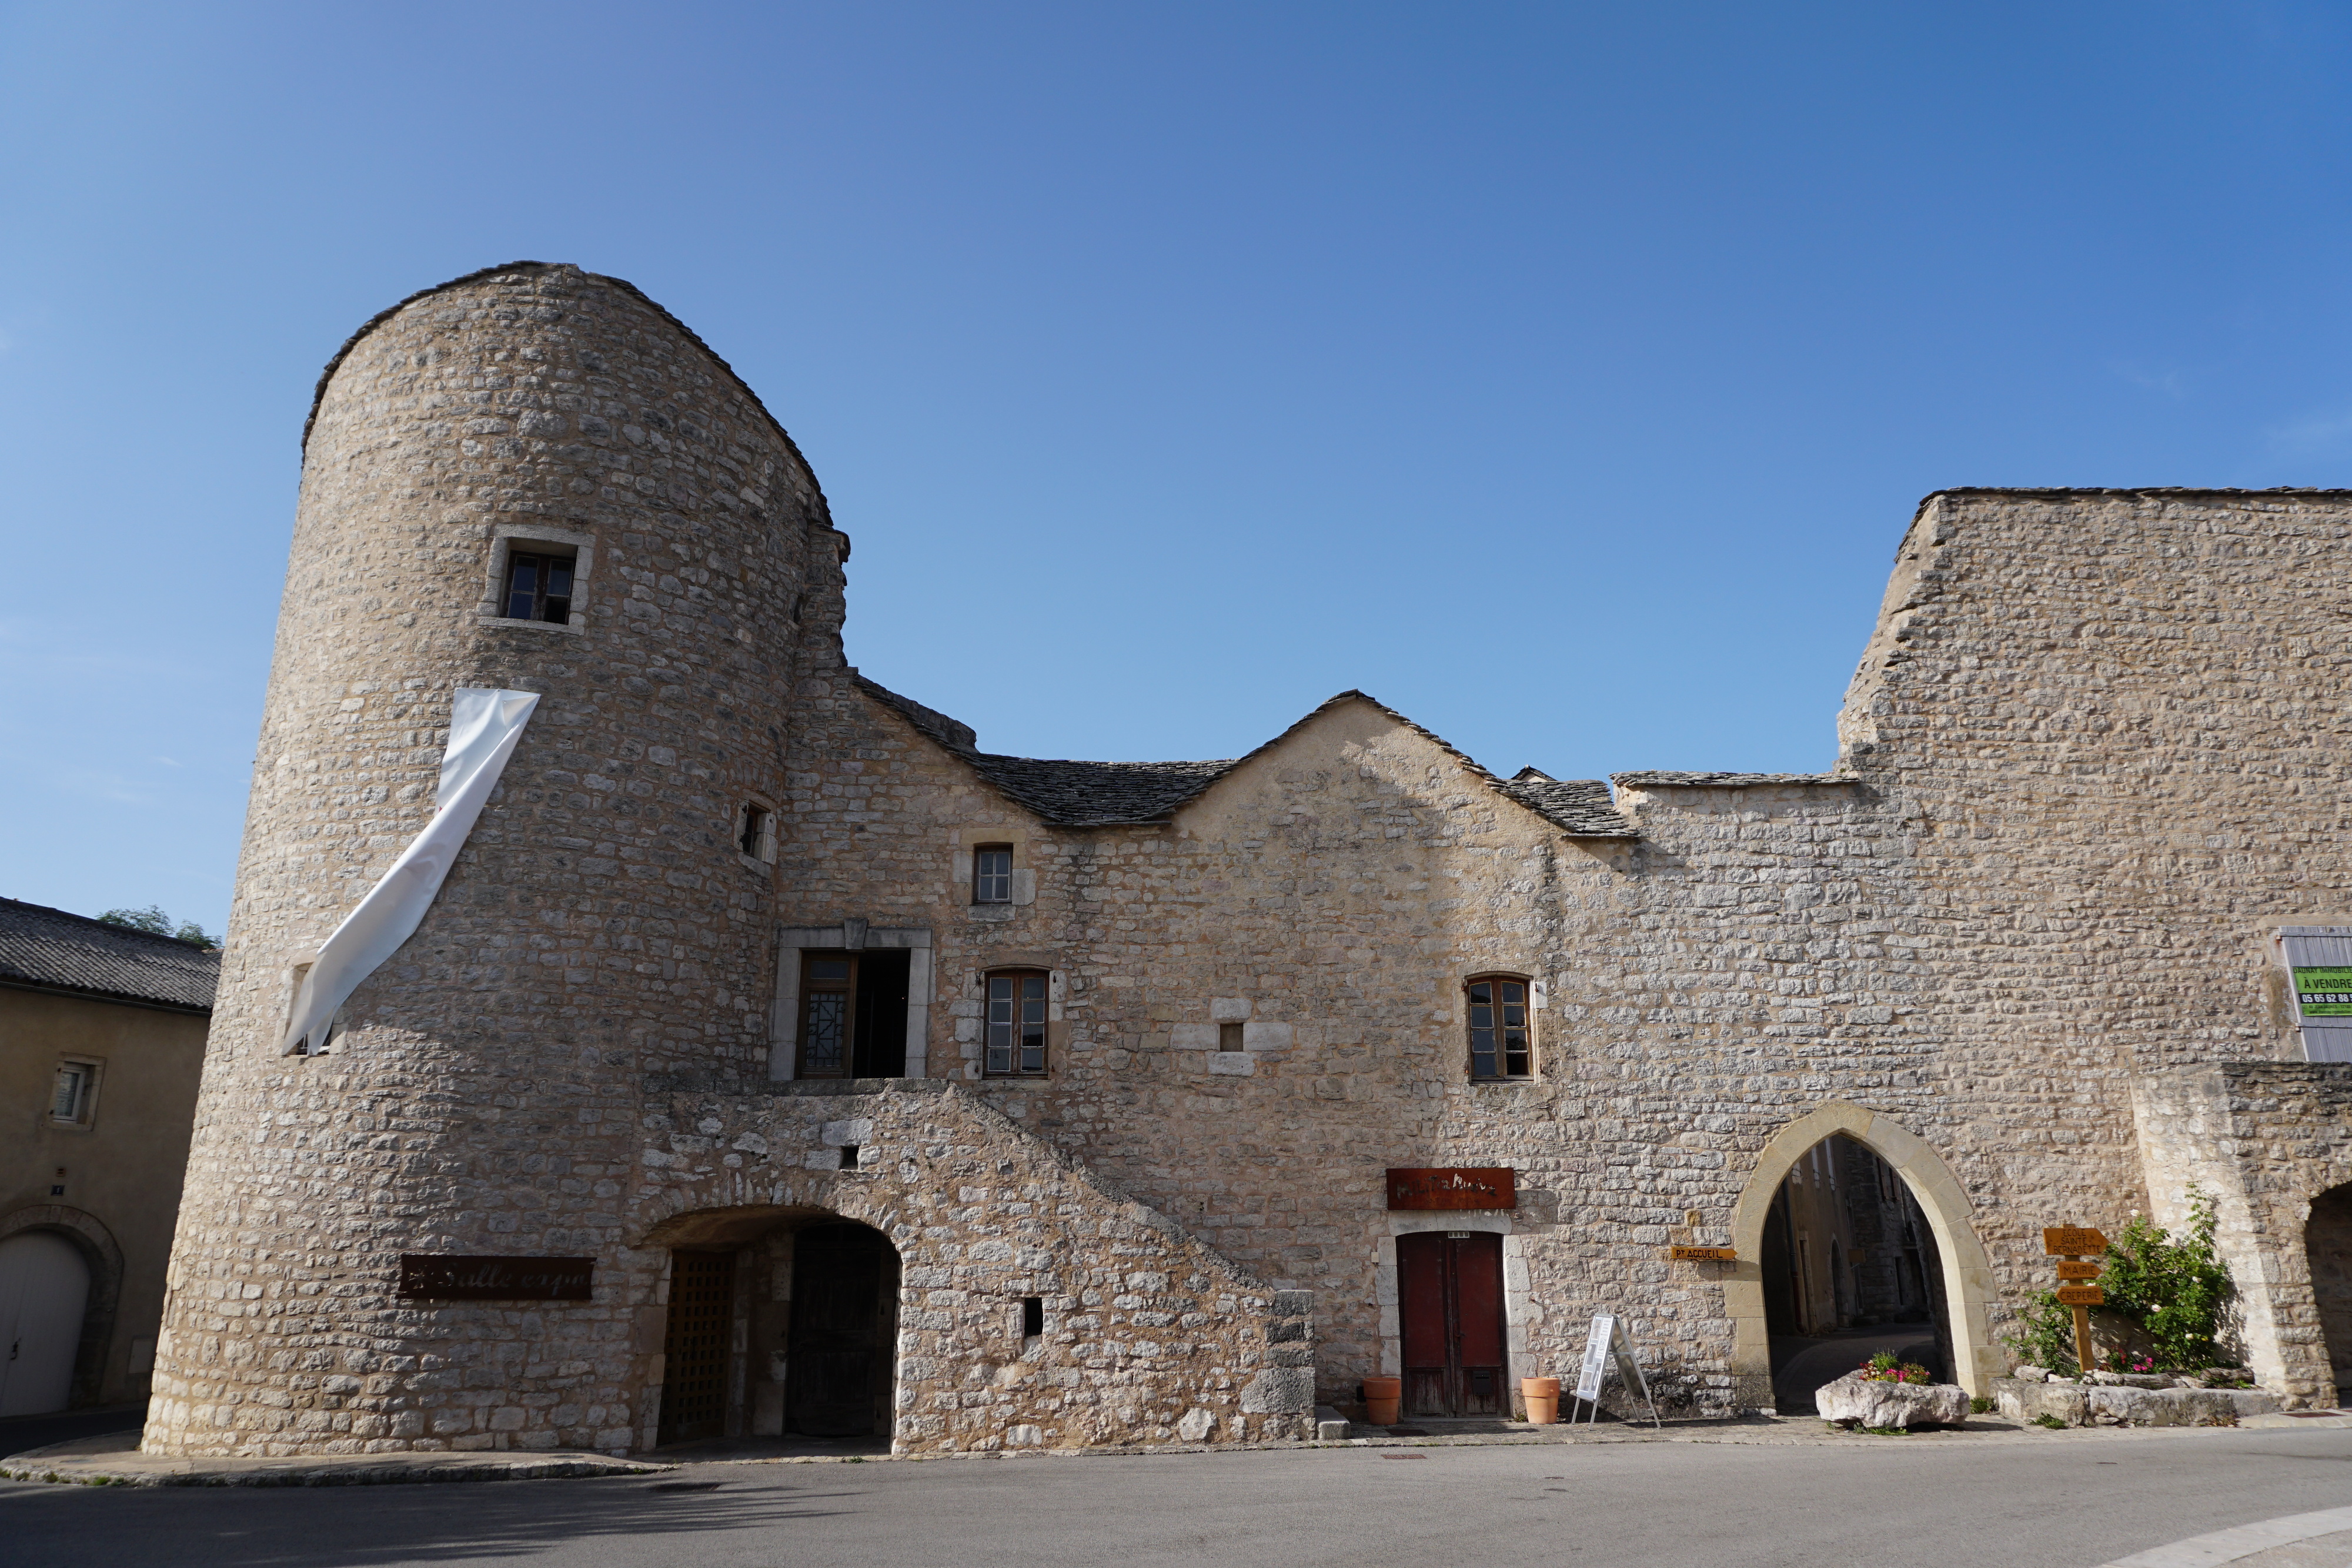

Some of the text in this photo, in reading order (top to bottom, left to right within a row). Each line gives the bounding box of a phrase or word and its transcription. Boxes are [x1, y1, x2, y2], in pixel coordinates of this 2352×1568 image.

[2304, 977, 2352, 989] À VENDRE
[2302, 994, 2313, 1002] 05
[2314, 994, 2325, 1002] 65
[2326, 994, 2337, 1002] 62
[2338, 994, 2349, 1002] 88
[2060, 1237, 2088, 1245] SAINTE
[2053, 1245, 2102, 1253] BERNADETTE
[1687, 1250, 1723, 1258] ACCUEIL
[2063, 1266, 2096, 1275] MAIRIE
[438, 1262, 587, 1296] Salle expo
[2060, 1291, 2099, 1300] CREPERIE
